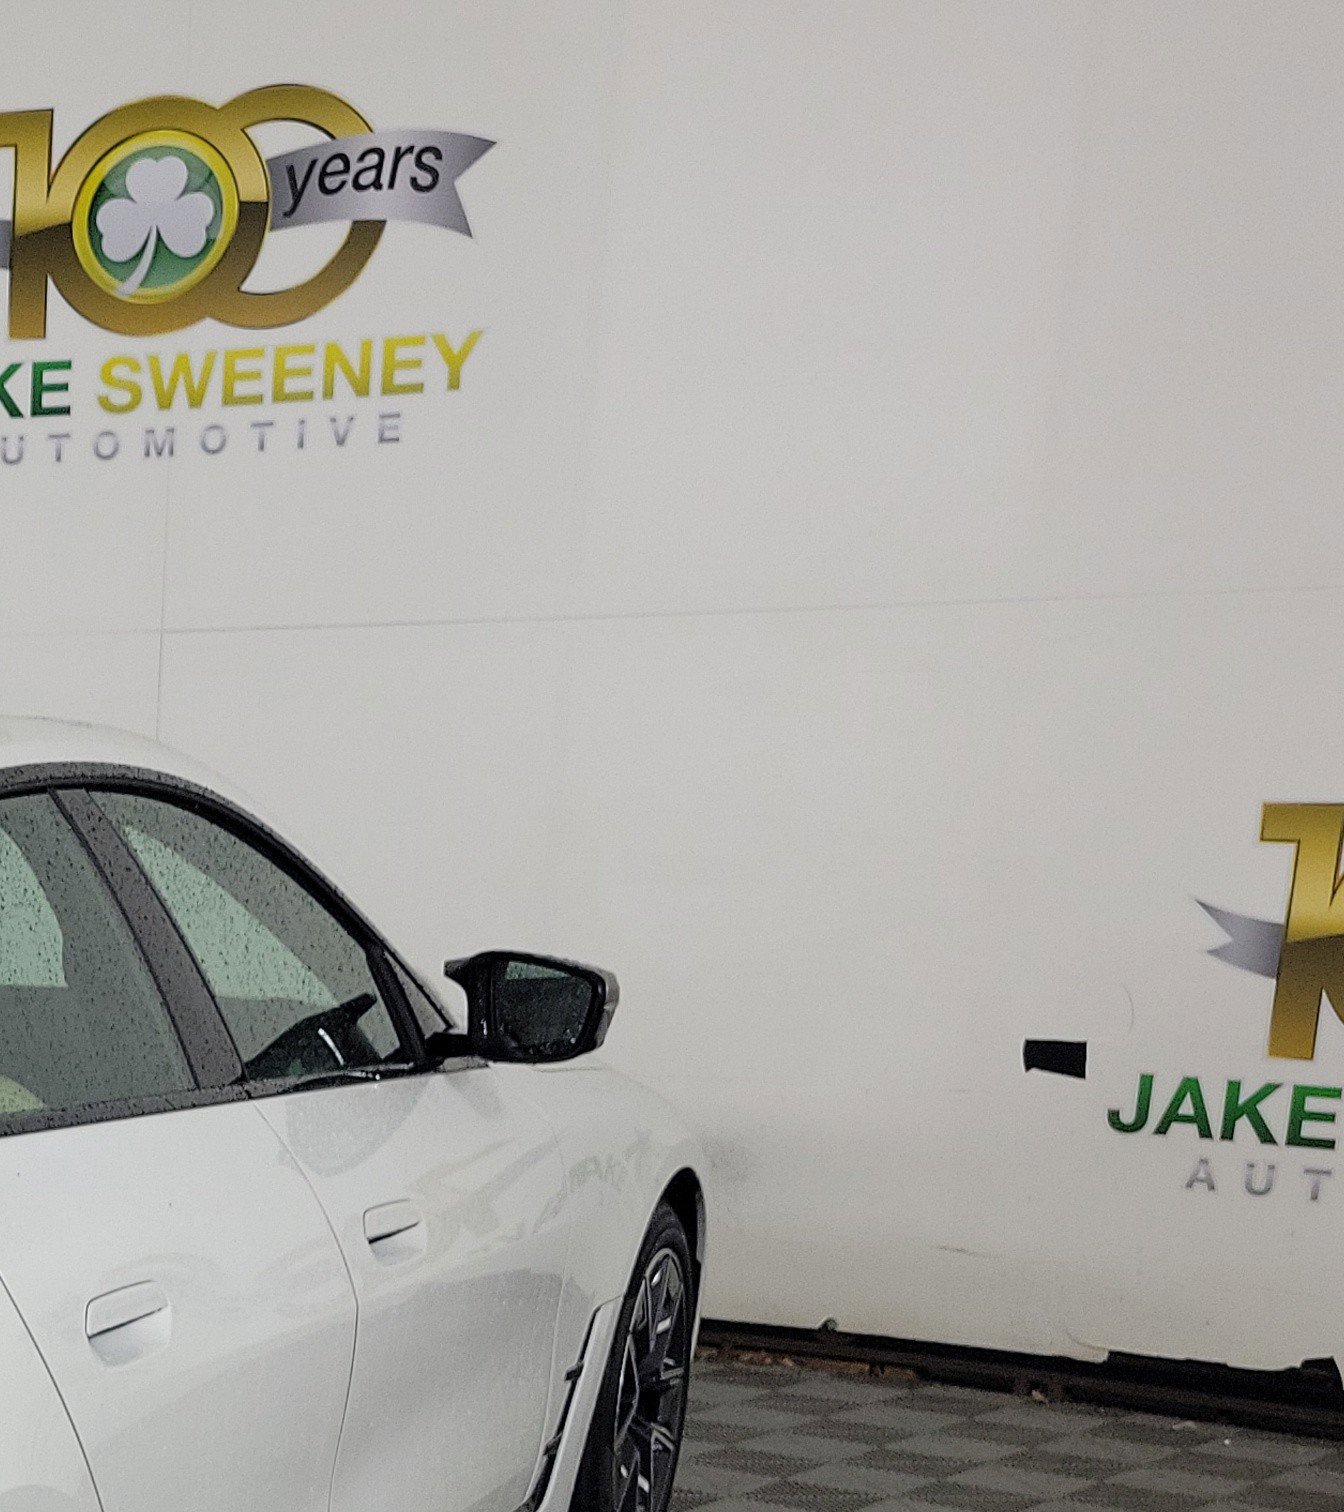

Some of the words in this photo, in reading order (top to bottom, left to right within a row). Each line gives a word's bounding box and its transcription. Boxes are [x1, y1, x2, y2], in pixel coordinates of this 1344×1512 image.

[282, 141, 443, 216] years
[97, 331, 485, 414] SWEENEY
[1107, 1074, 1343, 1149] JAKE
